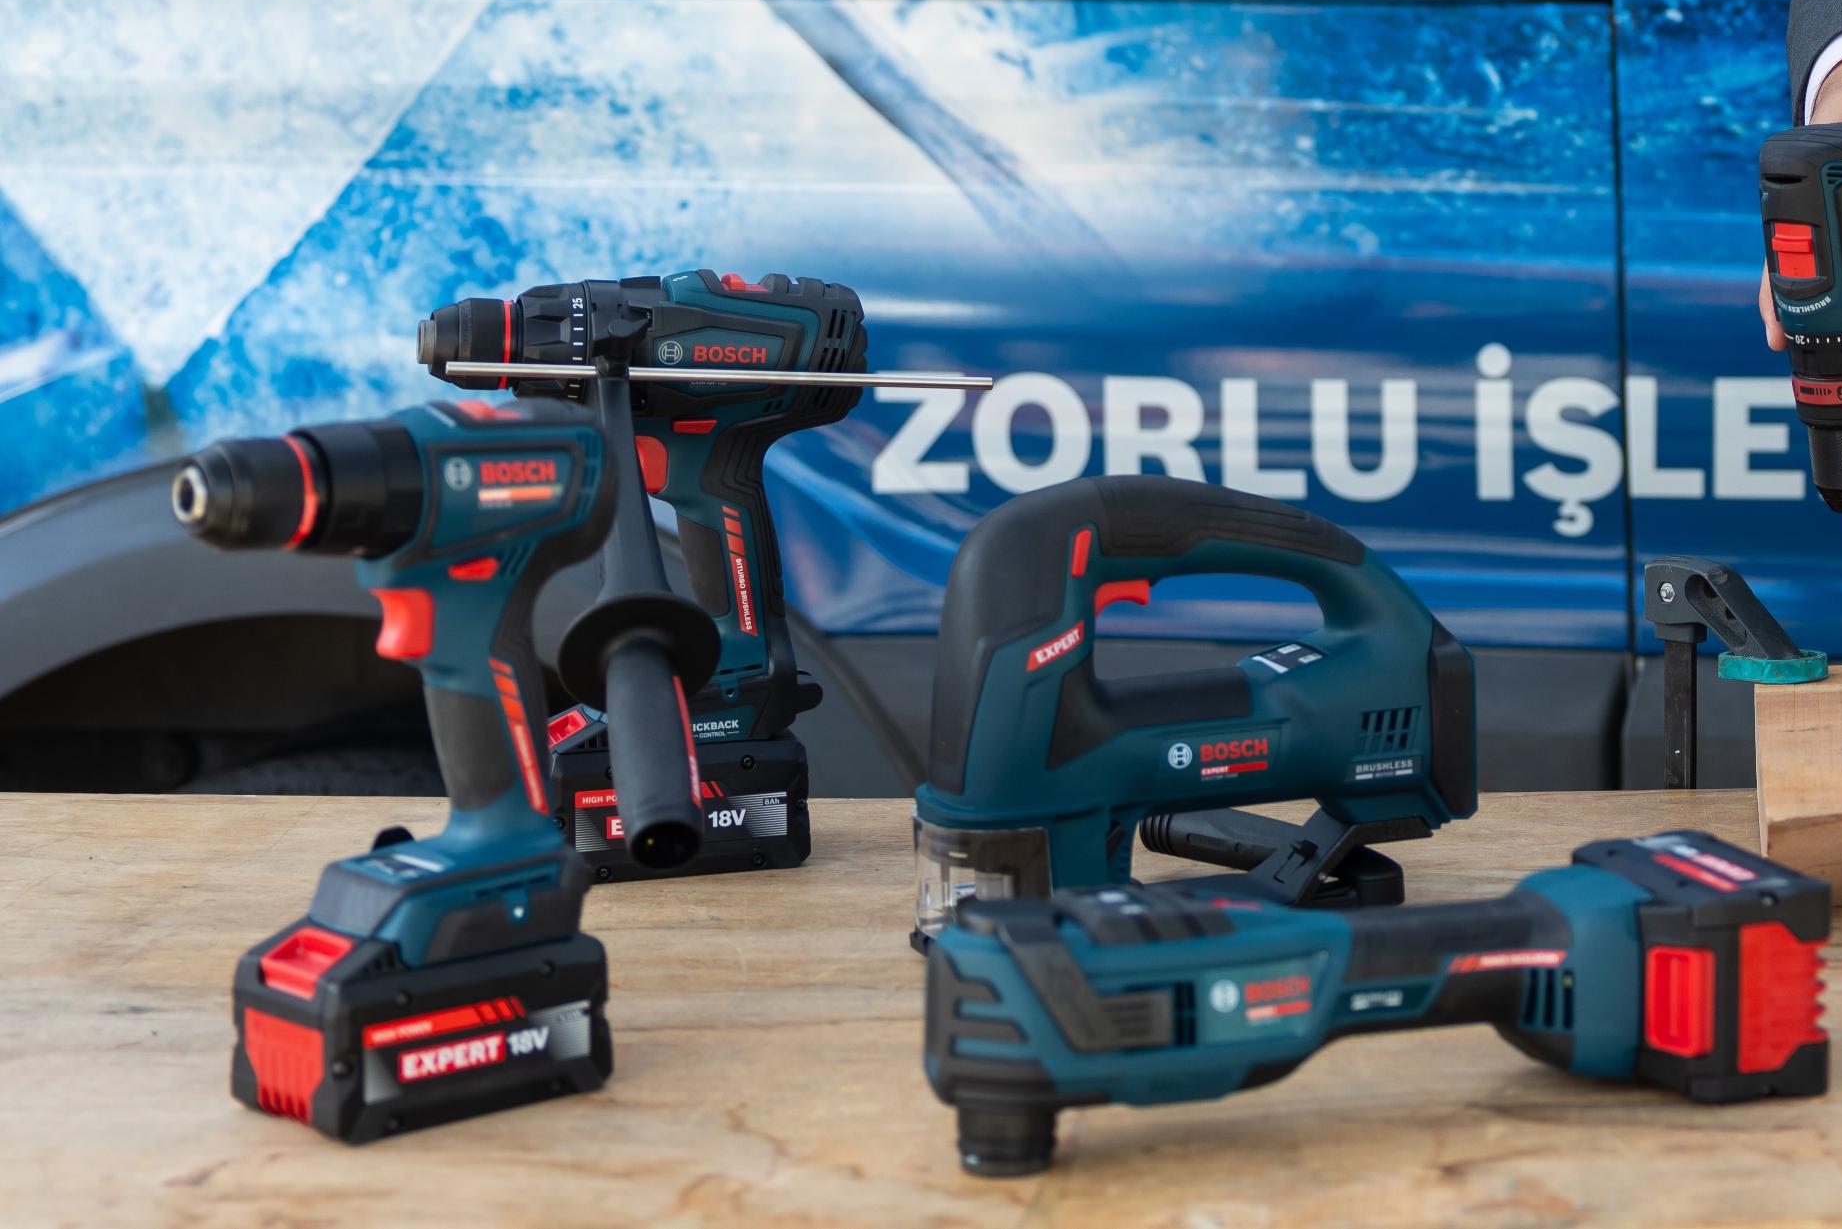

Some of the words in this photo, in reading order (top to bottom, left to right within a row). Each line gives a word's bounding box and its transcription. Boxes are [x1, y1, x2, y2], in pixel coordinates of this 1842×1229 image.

[572, 298, 583, 309] 25
[693, 345, 767, 364] BOSCH
[873, 371, 1418, 501] ZORLU
[479, 458, 557, 485] BOSCH
[1035, 628, 1080, 664] EXPERT
[692, 719, 740, 732] ICKBACK
[699, 731, 727, 739] CONTROL
[1200, 738, 1268, 763] BOSCH
[1355, 759, 1413, 774] BRUSHLESS
[582, 795, 604, 805] HIGH
[708, 808, 746, 828] 18V
[402, 1035, 503, 1081] EXPERT
[506, 1025, 549, 1056] 18V
